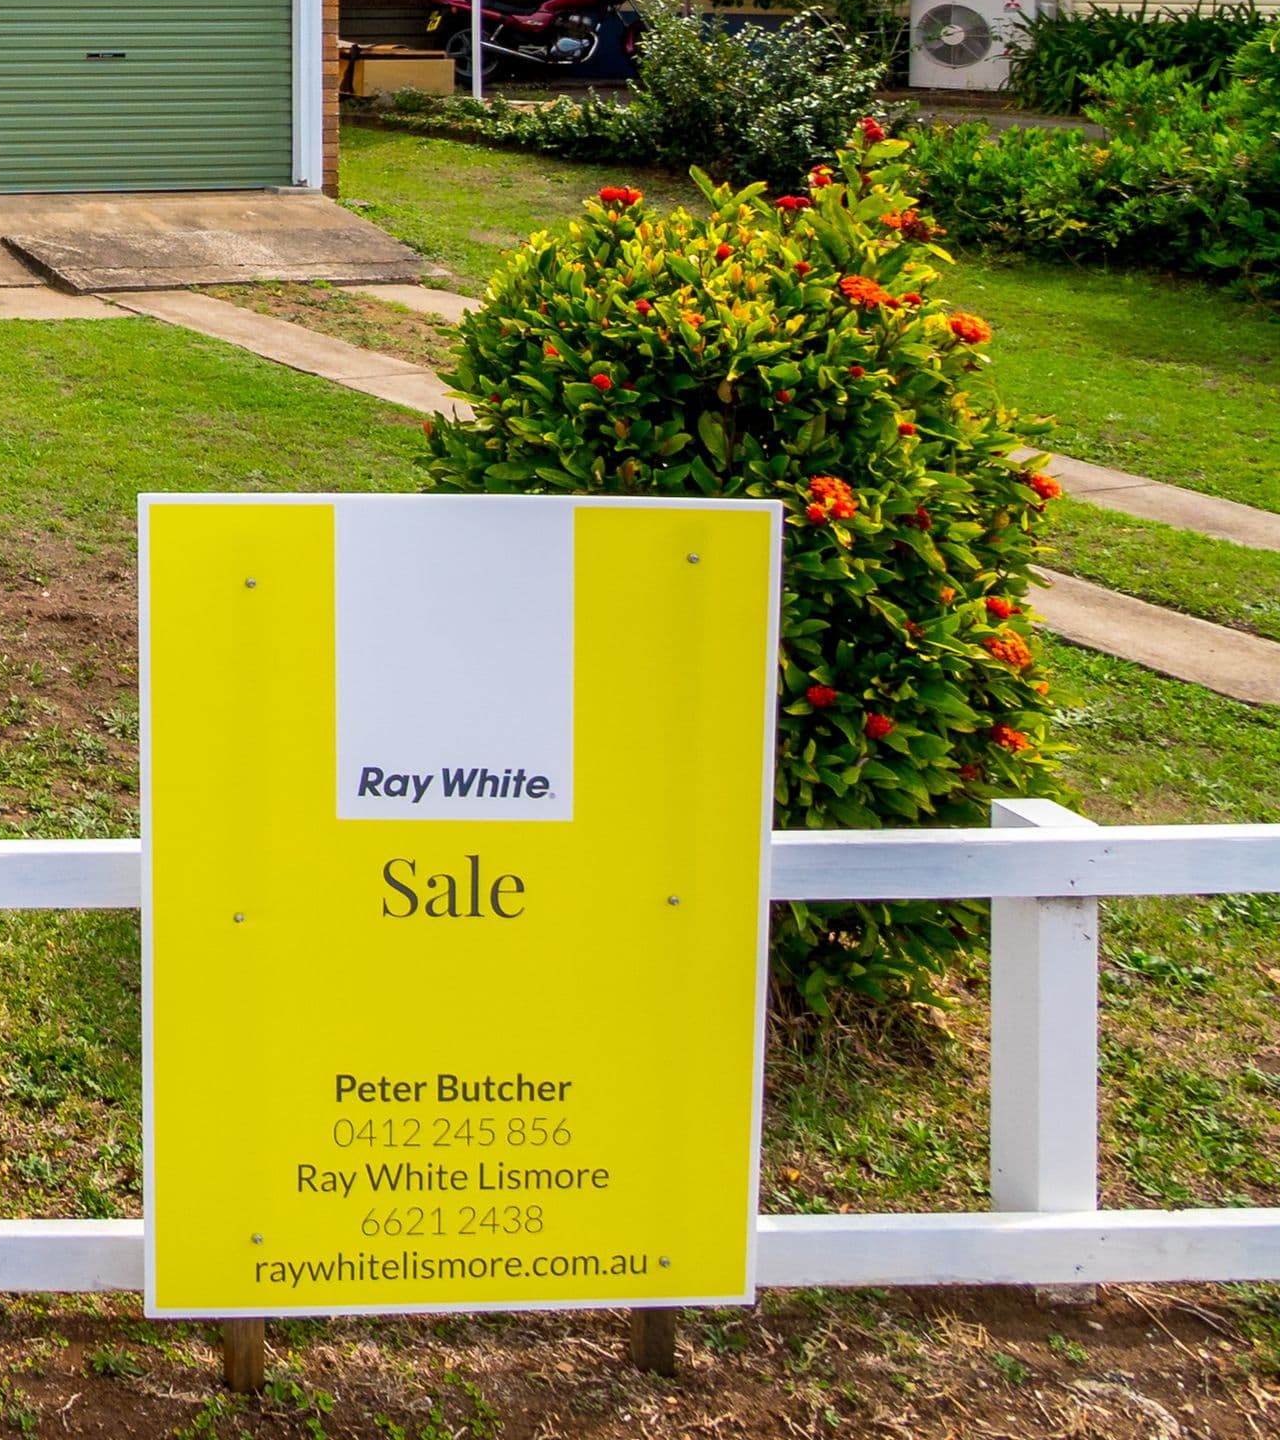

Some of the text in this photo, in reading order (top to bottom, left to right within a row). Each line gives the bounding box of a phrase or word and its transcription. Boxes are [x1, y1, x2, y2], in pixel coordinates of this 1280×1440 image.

[358, 766, 433, 803] Ray
[382, 854, 525, 919] Sale
[335, 1072, 572, 1103] Peter Butcher
[332, 1117, 572, 1148] 0412 245 856
[297, 1161, 610, 1198] Ray White Lismore
[360, 1205, 544, 1237] 6621 2438
[255, 1250, 648, 1289] raywhitelismore.com.au
